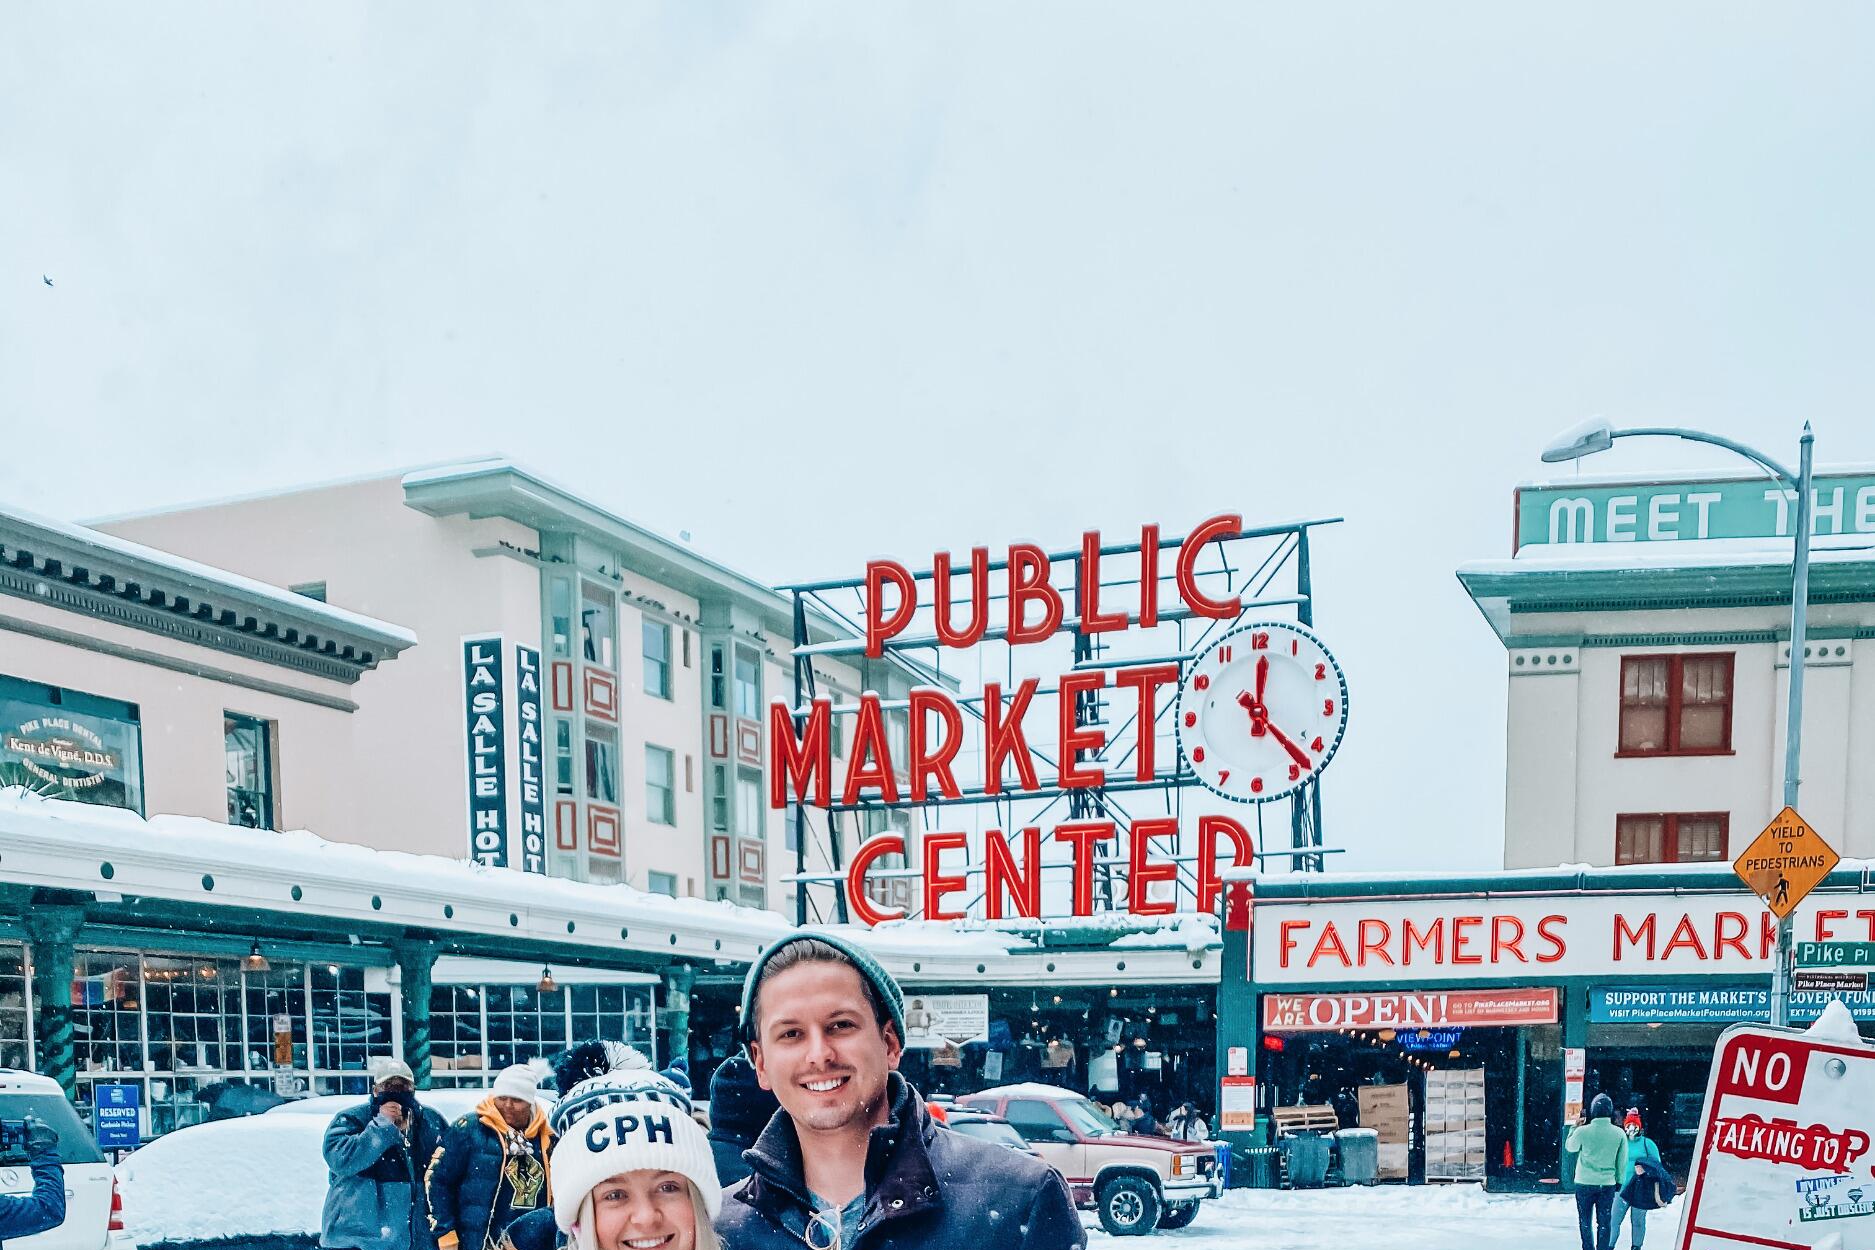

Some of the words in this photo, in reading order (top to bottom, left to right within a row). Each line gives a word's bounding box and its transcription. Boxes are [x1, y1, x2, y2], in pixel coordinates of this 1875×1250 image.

[1549, 492, 1721, 544] MEET
[1764, 485, 1875, 536] THE
[866, 514, 1242, 659] PUBLIC
[1251, 632, 1269, 650] 12
[1292, 639, 1298, 656] 1
[1219, 646, 1231, 664] 11
[470, 645, 496, 686] LA
[520, 650, 538, 692] LA
[1315, 663, 1326, 681] 2
[1193, 674, 1209, 691] 10
[1323, 698, 1334, 716] 3
[20, 720, 40, 735] PIKE
[42, 718, 70, 729] PLACE
[1185, 711, 1197, 728] 9
[472, 692, 499, 796] SALLE
[771, 664, 1179, 810] MARKET
[1310, 736, 1324, 753] 4
[10, 737, 35, 753] Kent
[38, 743, 50, 755] de
[84, 751, 114, 768] D.D.S.
[521, 701, 540, 802] SALLE
[1193, 746, 1205, 763] 8
[22, 758, 59, 785] GENERAL
[62, 771, 105, 788] DENTISTRY
[1218, 769, 1230, 786] 7
[1288, 764, 1300, 781] 5
[1251, 777, 1263, 793] 6
[1771, 826, 1805, 839] YIELD
[1779, 842, 1793, 854] TO
[848, 814, 1253, 927] CENTER
[1746, 855, 1825, 870] PEDESTRIANS
[1280, 913, 1568, 969] FARMERS
[1803, 943, 1844, 962] Pike
[1855, 949, 1869, 962] Pl
[1797, 980, 1815, 988] Pike
[1815, 980, 1835, 988] Place
[1277, 998, 1304, 1011] WE
[1605, 992, 1666, 1005] SUPPORT
[1671, 992, 1696, 1004] THE
[1699, 991, 1767, 1004] MARKET'S
[1789, 991, 1841, 1004] COVERY
[1271, 1011, 1305, 1025] ARE
[1309, 995, 1449, 1025] OPEN!
[1609, 1009, 1630, 1017] VISIT
[1631, 1008, 1770, 1019] PikePlaceMarketFoundation.org
[1790, 1008, 1806, 1017] EXT
[1396, 1032, 1462, 1043] VIEWPOINT
[1731, 1047, 1792, 1091] NO
[99, 1107, 136, 1117] RESERVED
[585, 1115, 674, 1153] CPH
[1712, 1119, 1806, 1159] TALKING
[1812, 1136, 1840, 1164] TO
[1803, 1207, 1812, 1219] IS
[1814, 1204, 1836, 1218] JUST
